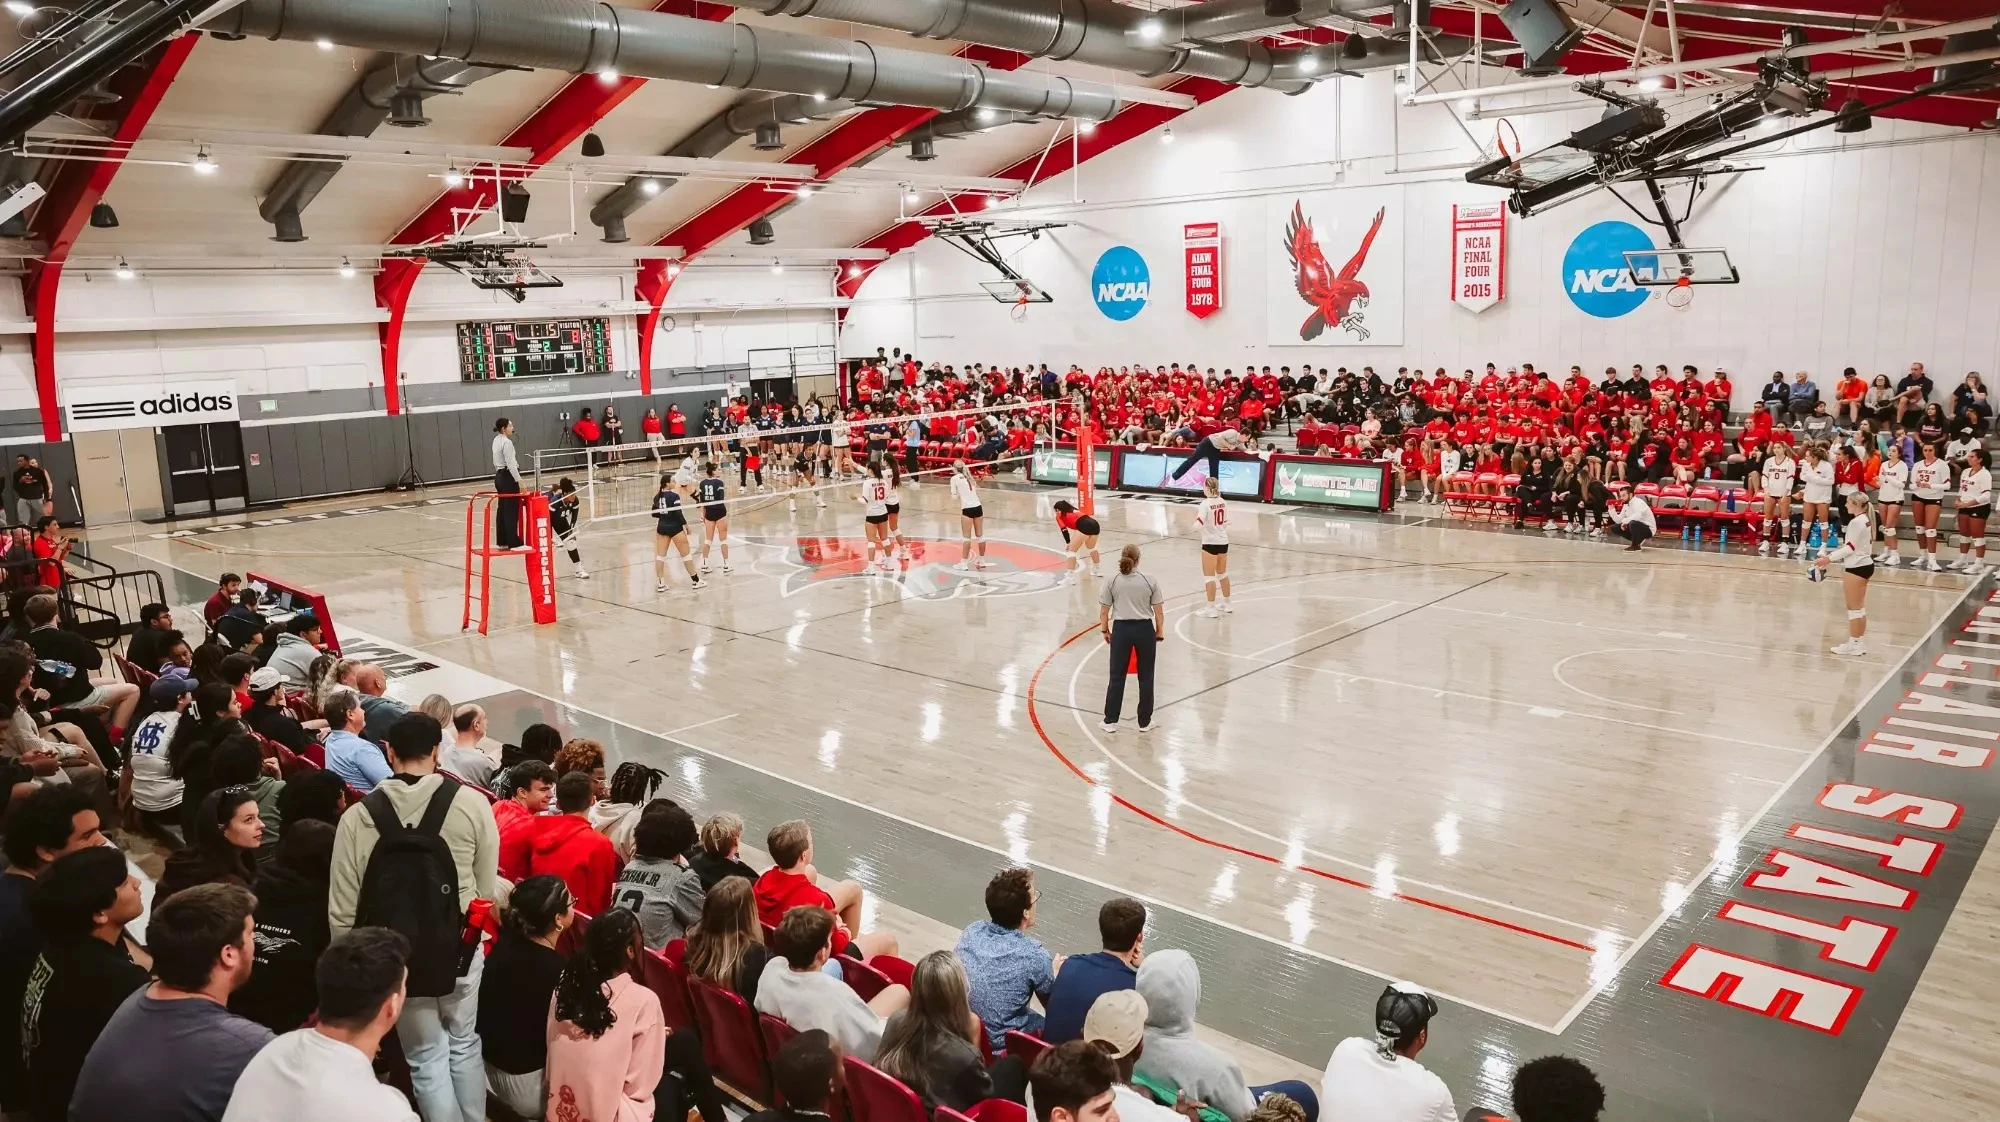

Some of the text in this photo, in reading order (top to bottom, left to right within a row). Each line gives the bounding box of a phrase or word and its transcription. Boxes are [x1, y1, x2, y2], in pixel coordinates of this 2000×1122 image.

[1465, 236, 1490, 248] NCAA
[1191, 252, 1212, 264] AIAW
[1464, 251, 1492, 262] FINAL
[1191, 265, 1212, 276] FINAL
[1464, 266, 1490, 277] FOUR
[1191, 278, 1212, 288] FOUR
[1570, 268, 1654, 294] NCAA
[1098, 282, 1148, 302] NCAA
[1464, 284, 1490, 298] 2015
[1191, 293, 1212, 306] 1978
[530, 324, 556, 337] 1:15
[572, 330, 579, 343] 8
[543, 341, 550, 352] 2
[140, 392, 232, 416] adidas
[705, 485, 713, 495] 13
[1302, 475, 1378, 492] MONTCLAIR
[874, 487, 885, 500] 13
[1214, 509, 1224, 526] 10
[537, 518, 552, 604] MONTCLAIR
[646, 873, 660, 887] JR
[1658, 782, 1964, 1036] STATE
[261, 924, 291, 935] BROTHERS
